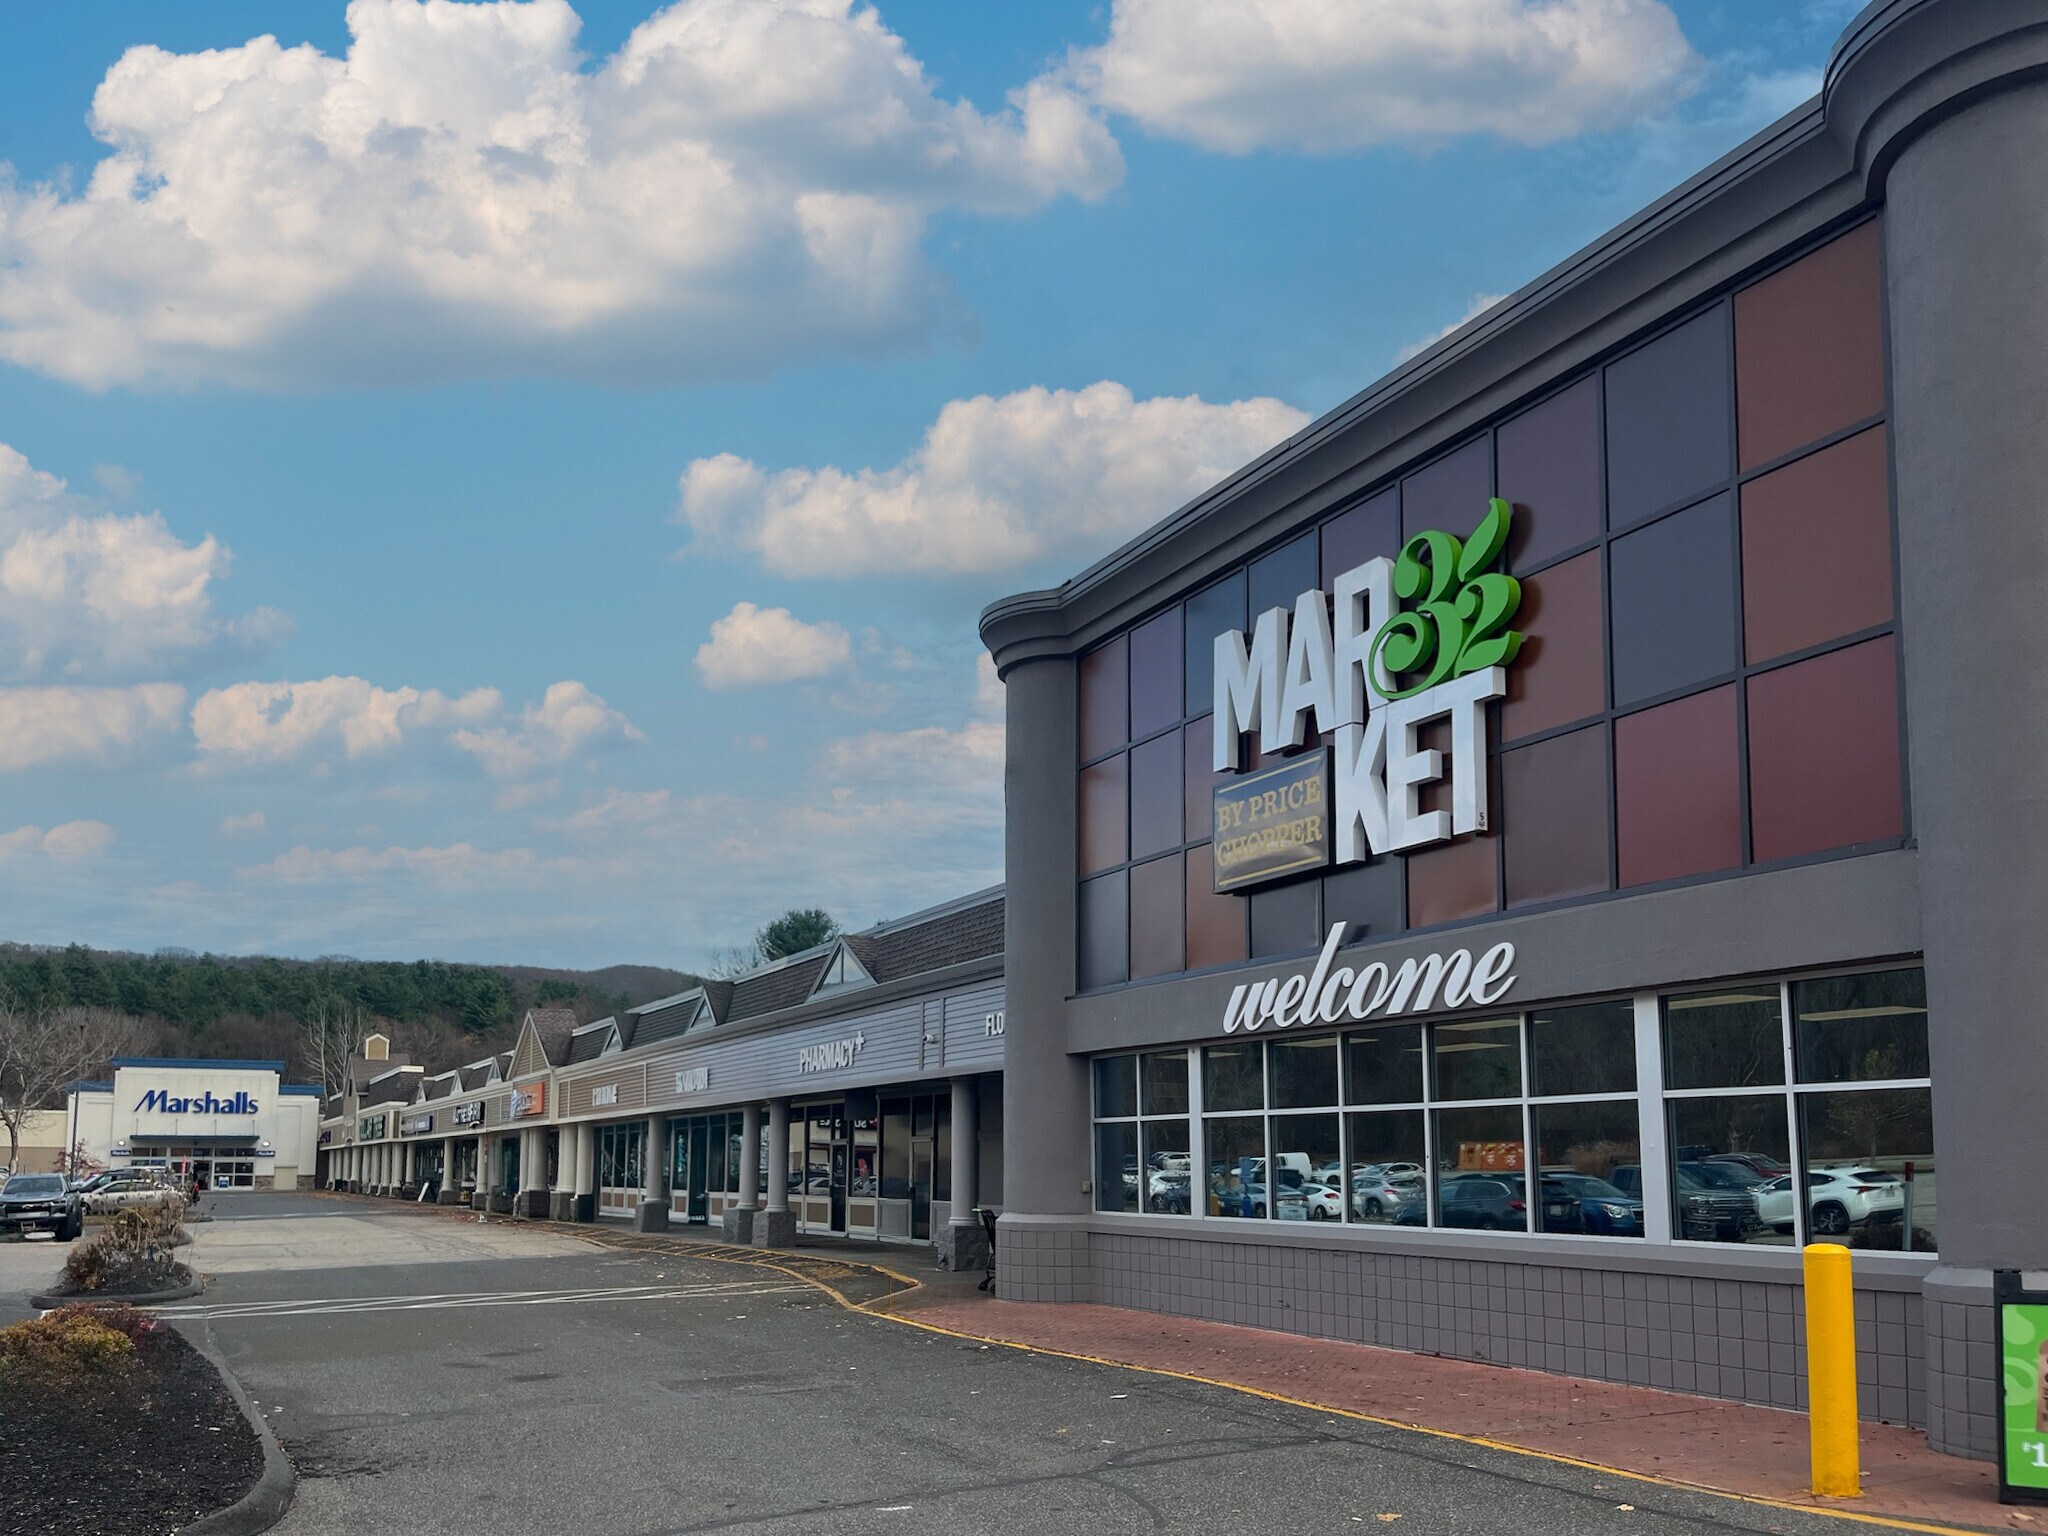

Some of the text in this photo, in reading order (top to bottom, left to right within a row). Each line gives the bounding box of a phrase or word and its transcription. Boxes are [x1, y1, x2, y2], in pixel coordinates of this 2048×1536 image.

[1213, 556, 1400, 772] MAR
[1218, 775, 1321, 832] BY PRICE
[1335, 666, 1506, 865] KET
[1217, 815, 1322, 867] CHOPPER
[1223, 921, 1518, 1034] welcome
[134, 1089, 259, 1114] Marshalls
